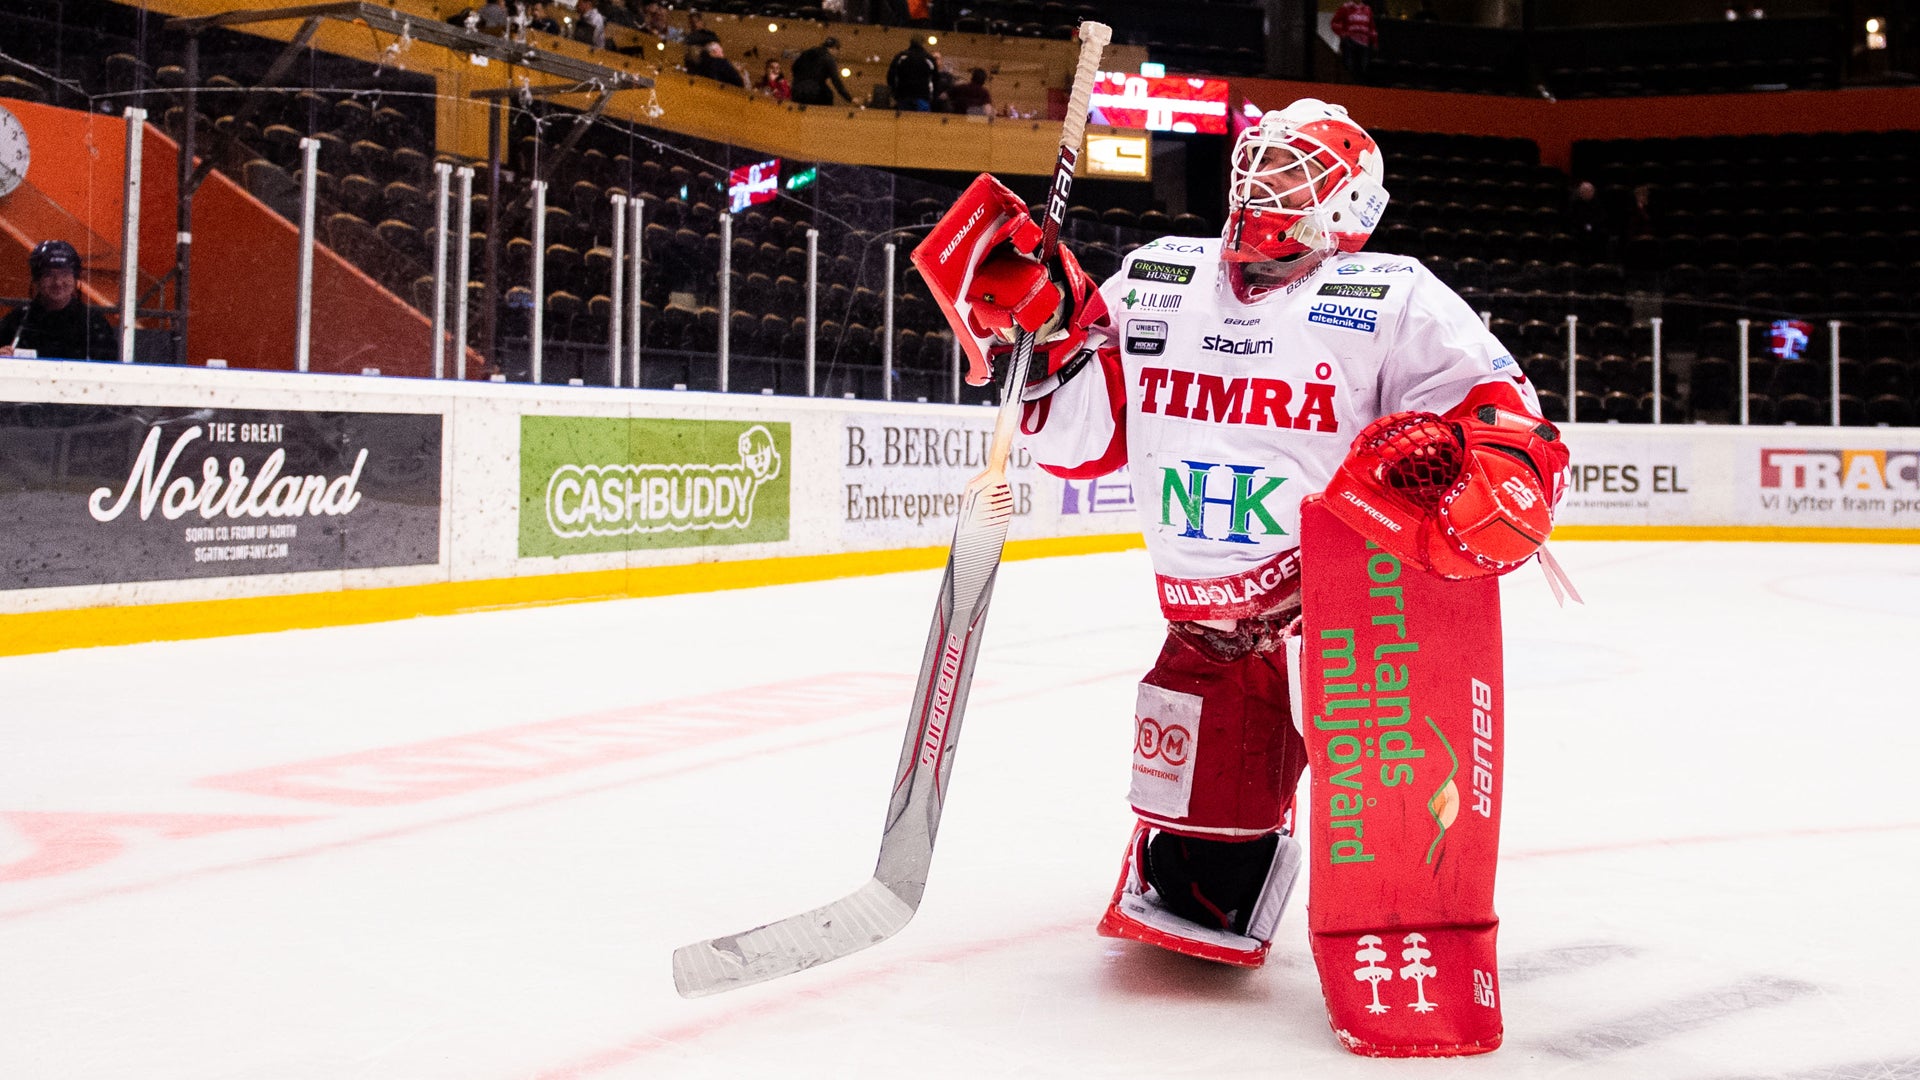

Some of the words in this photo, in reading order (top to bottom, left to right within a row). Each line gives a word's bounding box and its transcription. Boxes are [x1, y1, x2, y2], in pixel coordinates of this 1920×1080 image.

[12, 130, 18, 140] 2
[16, 149, 22, 160] 3
[938, 203, 986, 265] SUPREME
[1163, 242, 1205, 255] SCA
[1134, 261, 1190, 277] GRÖNSAKS
[1146, 271, 1179, 282] HUSET
[1286, 260, 1324, 295] BAUER
[1141, 292, 1183, 309] LILIUM
[1310, 302, 1378, 321] JOWIC
[1135, 324, 1160, 332] UNIBET
[1224, 317, 1261, 326] BAUER
[1311, 314, 1355, 328] elteknik
[1356, 321, 1371, 331] ab
[1202, 334, 1274, 355] stadium
[1138, 362, 1339, 434] TIMRÅ
[208, 422, 236, 442] THE
[240, 423, 285, 442] GREAT
[845, 426, 873, 468] B.
[882, 426, 1032, 469] BERGLUD
[88, 425, 369, 522] Norrland
[1652, 465, 1688, 493] EL
[1766, 452, 1920, 490] TRAC
[554, 475, 752, 525] CASHBUDDY
[1158, 459, 1290, 544] NHK
[1340, 490, 1402, 533] SUPREME
[1760, 495, 1780, 510] Vi
[1787, 495, 1835, 514] lyfter
[1842, 496, 1886, 511] fram
[231, 524, 256, 541] FROM
[256, 524, 268, 539] UP
[269, 523, 298, 539] NORTH
[1365, 539, 1425, 788] orrlands
[922, 632, 963, 775] SUPREME
[1313, 628, 1377, 865] miljövård
[1471, 676, 1493, 819] BAUER
[1473, 969, 1496, 1009] 25
[1473, 982, 1482, 1004] PRO
